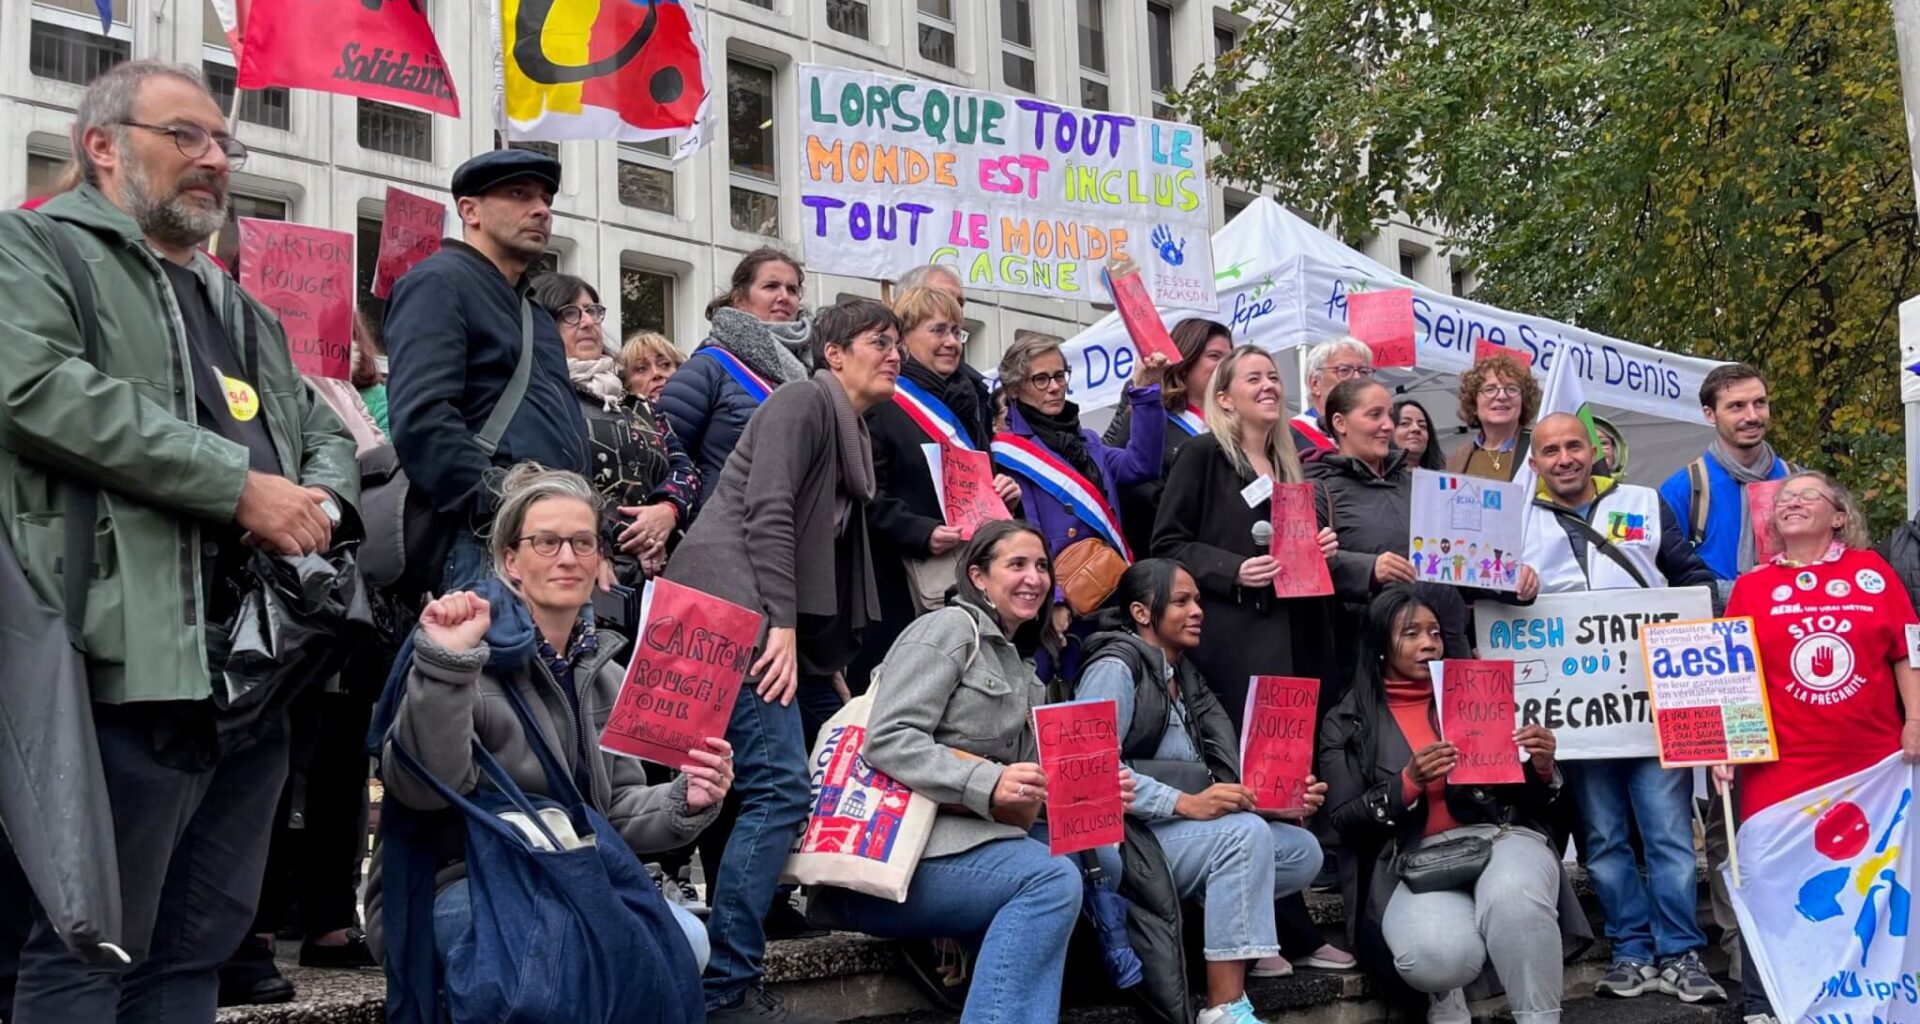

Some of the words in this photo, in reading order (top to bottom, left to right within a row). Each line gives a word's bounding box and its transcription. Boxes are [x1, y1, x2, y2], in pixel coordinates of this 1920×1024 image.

[811, 77, 1005, 145] LORSQUE
[1015, 99, 1135, 158] TOUT
[1151, 124, 1193, 168] LE
[806, 135, 958, 187] MONDE
[979, 154, 1049, 199] EST
[802, 195, 934, 246] TOUT
[948, 209, 990, 249] LE
[1000, 217, 1130, 262] MONDE
[1155, 274, 1201, 288] JESSEE
[1155, 289, 1209, 303] JACKSON
[1228, 292, 1277, 334] fcpe
[290, 337, 351, 362] LUSION
[1604, 346, 1681, 400] Denis
[1490, 616, 1564, 650] AESH
[1576, 612, 1679, 645] STAT
[1788, 615, 1852, 640] STOP
[646, 616, 754, 674] CARTON
[1652, 634, 1756, 679] aesh
[1446, 668, 1514, 696] CARTON
[1671, 680, 1689, 689] leur
[1793, 687, 1807, 703] LA
[1811, 673, 1868, 706] PRÉCARITÉ
[624, 687, 690, 720] POUR
[1458, 701, 1508, 722] ROUGE
[1514, 684, 1653, 729] RÉCARIT
[1040, 718, 1117, 747] CARTON
[1256, 714, 1307, 739] ROUGE
[1058, 753, 1110, 783] ROUGE
[1458, 751, 1519, 768] INCLUSION
[1051, 811, 1123, 841] L'INCLUSION
